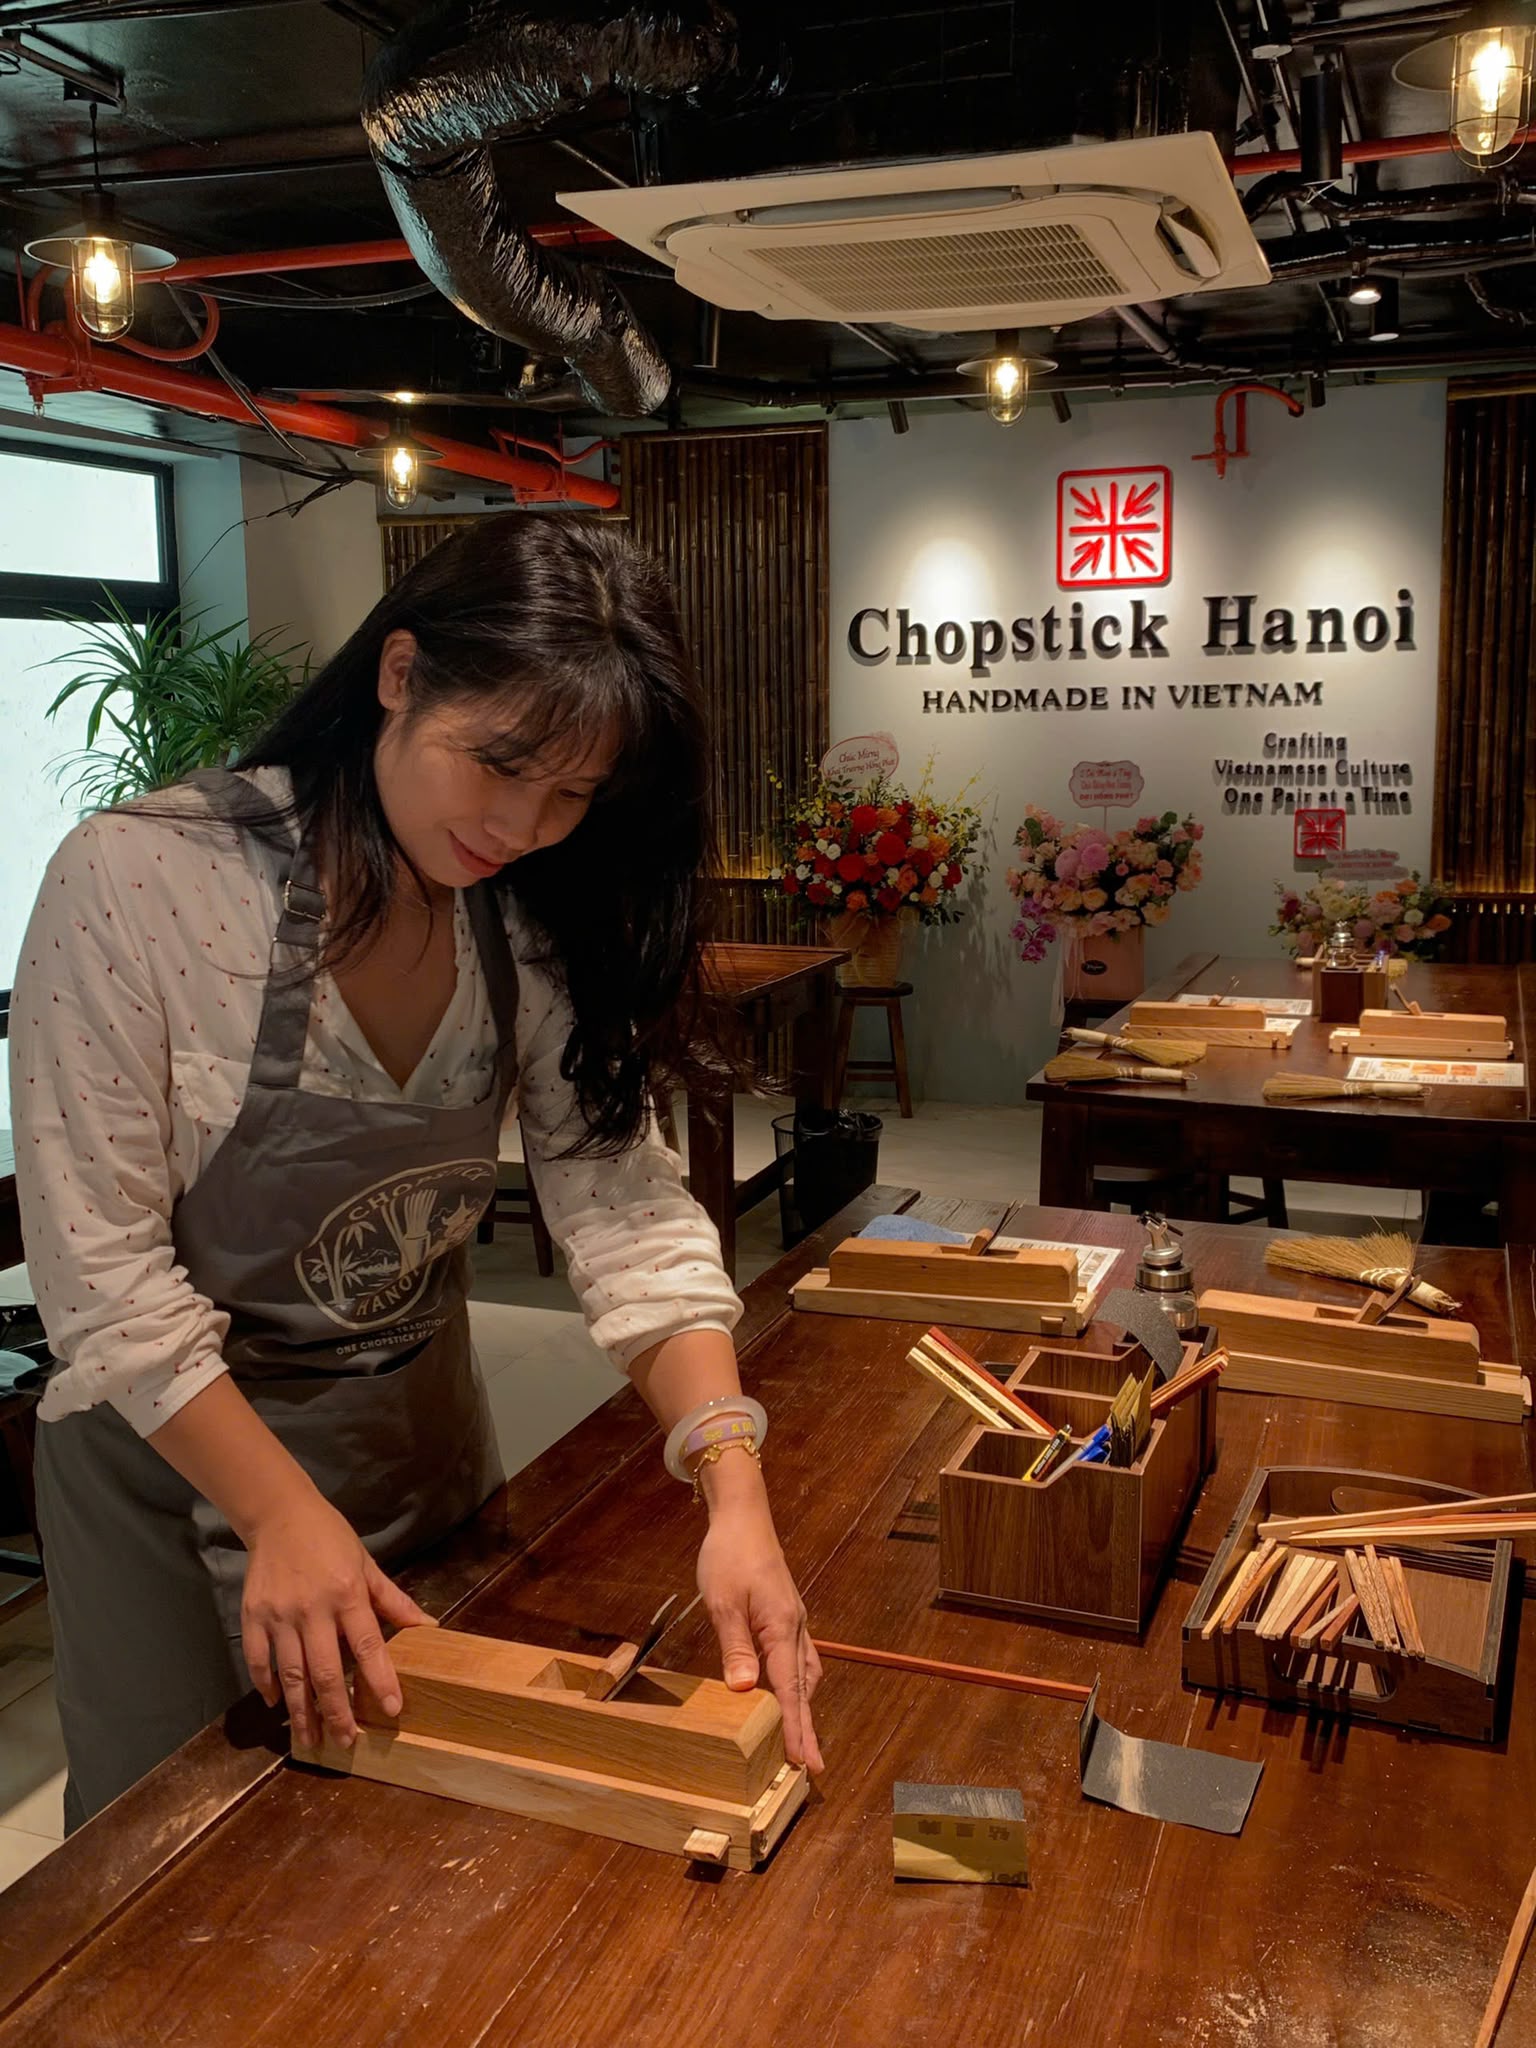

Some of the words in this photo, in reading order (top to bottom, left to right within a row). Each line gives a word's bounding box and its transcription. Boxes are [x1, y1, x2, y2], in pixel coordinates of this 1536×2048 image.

[848, 599, 1167, 672] Chopstick
[1204, 589, 1416, 650] Hanoi
[922, 687, 1108, 710] HANDMADE
[1123, 686, 1156, 706] IN
[1168, 682, 1322, 705] VIETNAM
[1265, 732, 1346, 750] Crafting
[1215, 760, 1326, 774] Vietnamese
[1336, 759, 1409, 774] Culture
[1225, 788, 1262, 803] One
[1273, 788, 1312, 802] Pair
[1319, 790, 1337, 802] at
[1345, 791, 1354, 802] a
[1362, 787, 1408, 802] Time
[336, 1344, 357, 1355] ONE
[360, 1333, 415, 1350] CHOPSTICK
